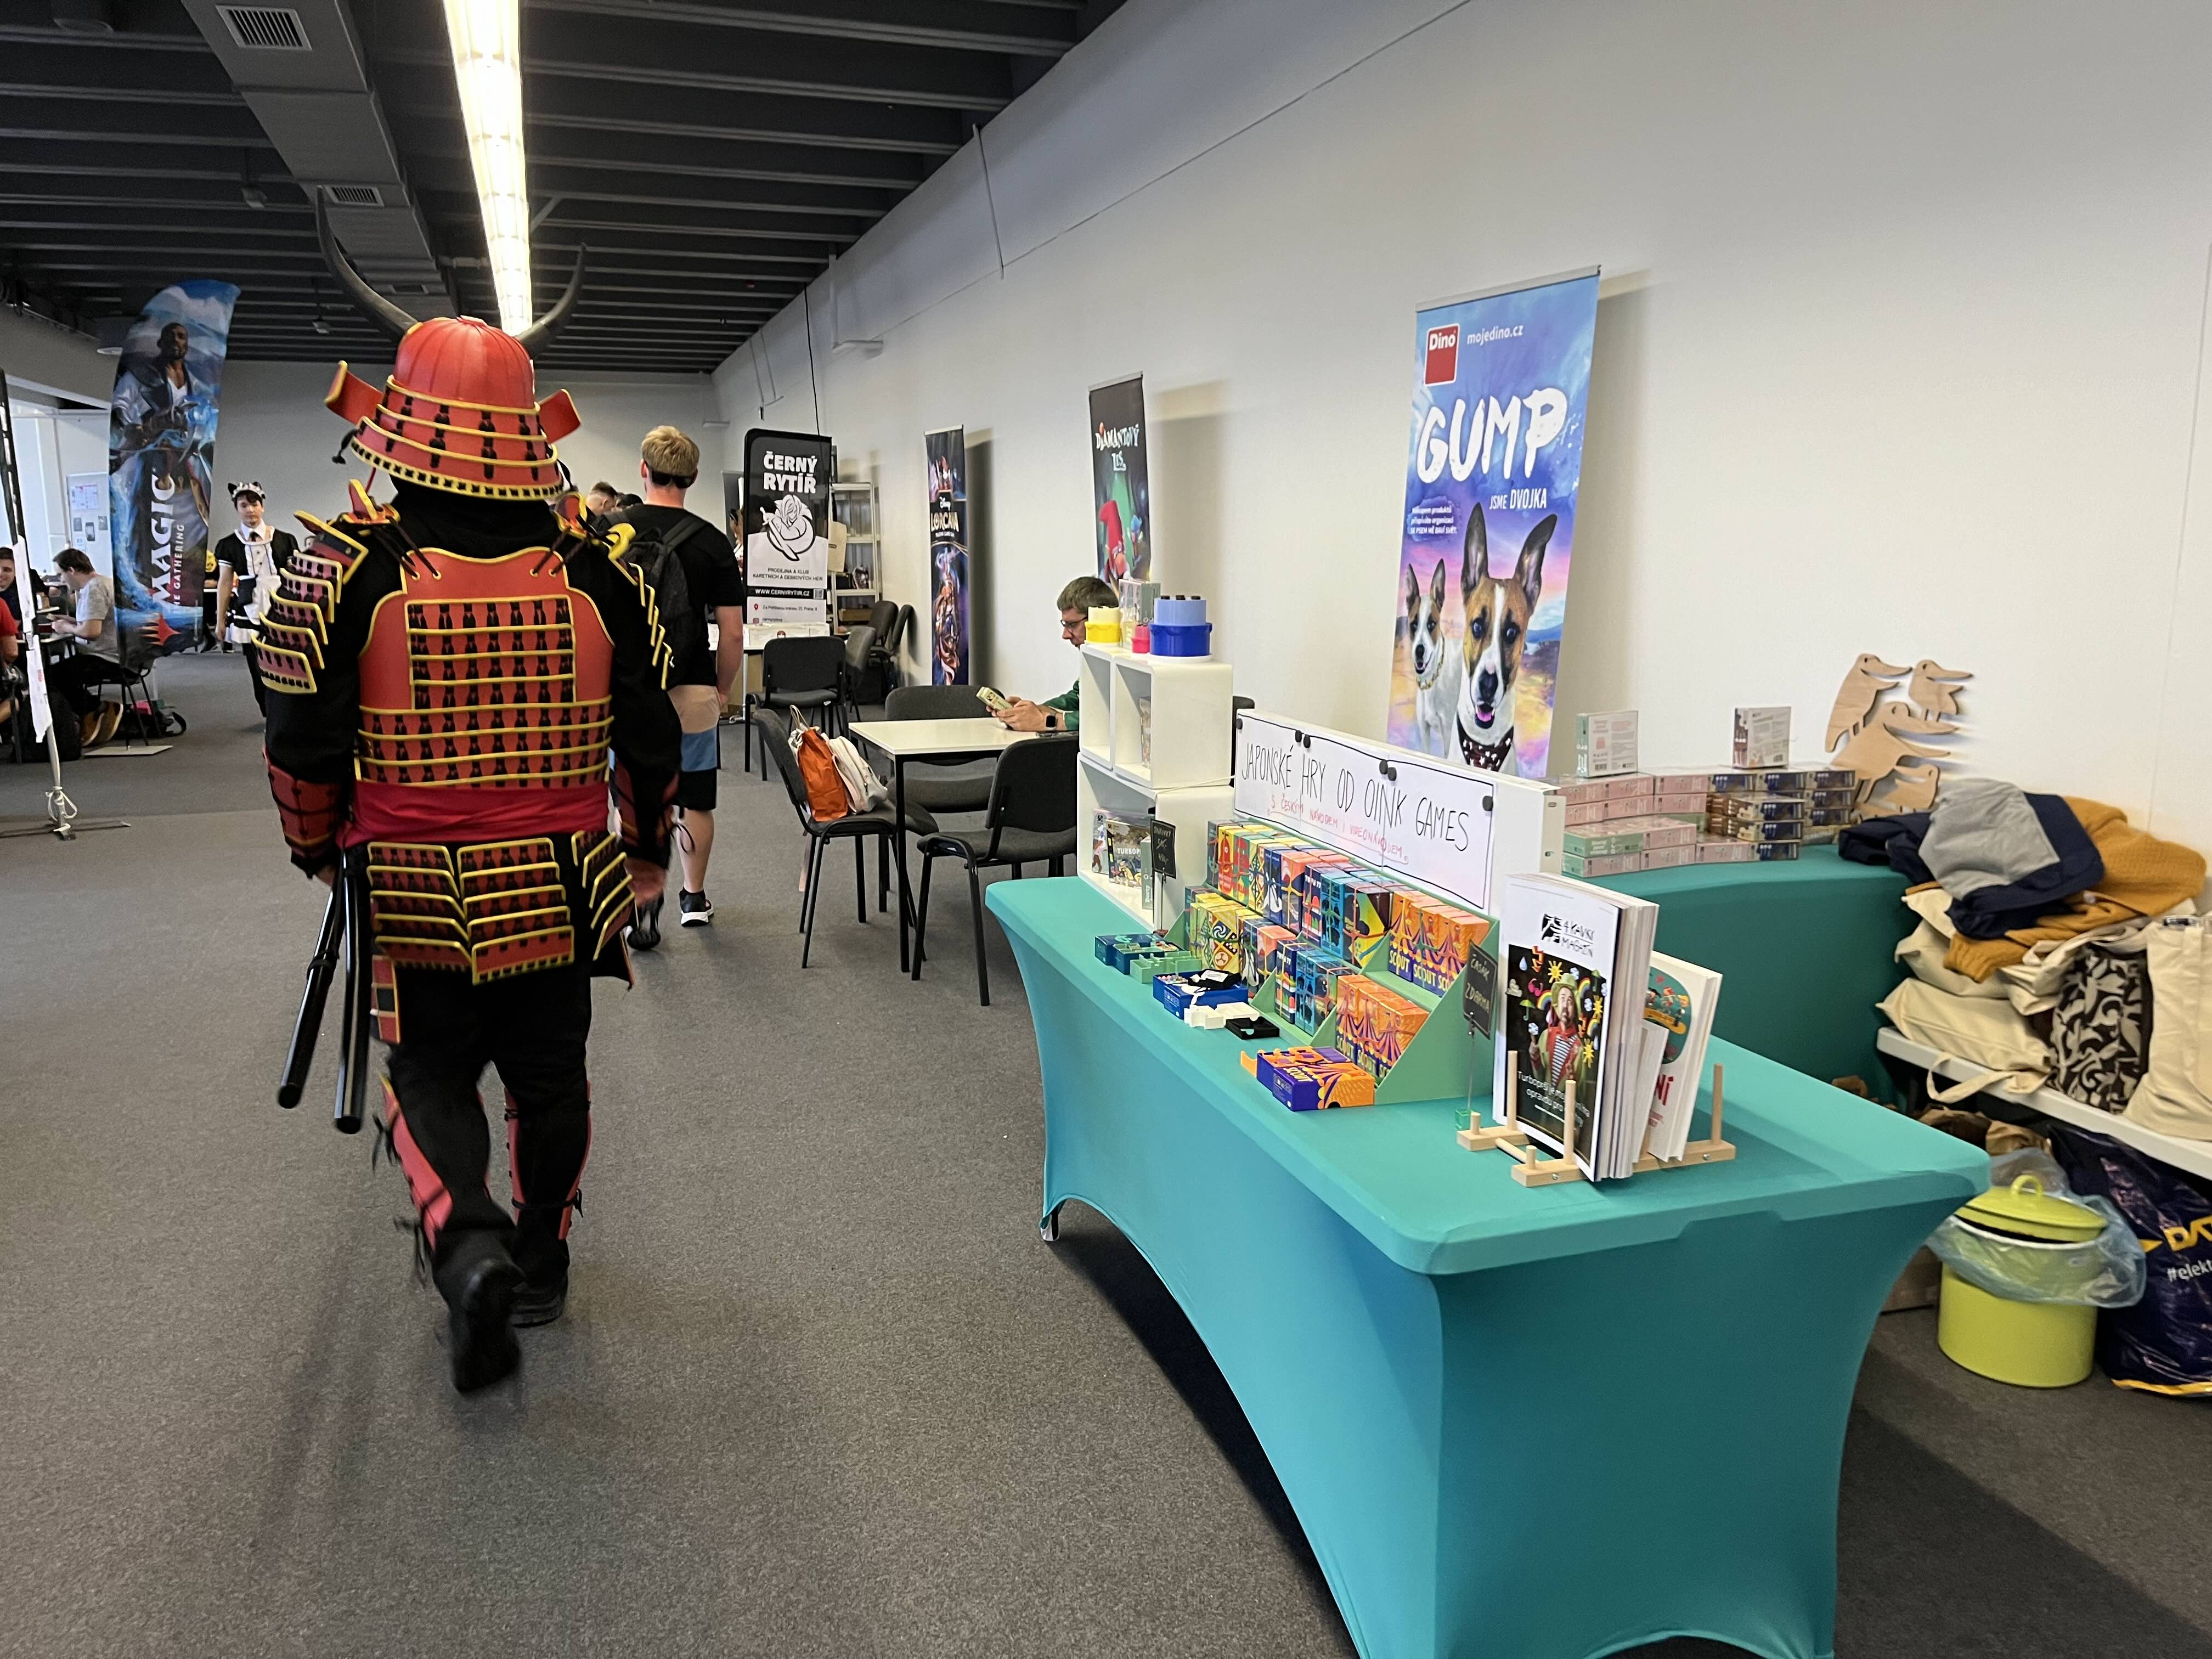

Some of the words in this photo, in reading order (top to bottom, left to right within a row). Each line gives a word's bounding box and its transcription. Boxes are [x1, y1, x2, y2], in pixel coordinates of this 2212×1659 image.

[1429, 331, 1456, 351] Dino
[1466, 325, 1523, 346] mojedino.cz
[1417, 387, 1567, 484] GUMP
[763, 450, 817, 473] ČERNÝ
[763, 472, 816, 494] RYTÍŘ
[1489, 494, 1508, 510] JSME
[1509, 487, 1547, 510] DVOJKA
[930, 511, 959, 532] LORCANA
[151, 473, 176, 608] MAGIC
[173, 524, 185, 590] GATHERING
[1242, 742, 1294, 791] JAPONSKÉ
[1301, 753, 1326, 803] HRY
[1337, 768, 1355, 813] OD
[1364, 779, 1407, 828] OINK
[1415, 797, 1469, 851] GAMES
[1271, 794, 1276, 809] S
[1310, 809, 1338, 828] NÁVODEM
[1389, 950, 1410, 973] SCOUT
[1413, 963, 1436, 986] SCOUT
[1465, 983, 1490, 1014] ZDARMA
[1337, 1035, 1354, 1062] SCOUT
[1283, 1066, 1313, 1082] SCOUT
[1357, 1049, 1376, 1076] SCOUT
